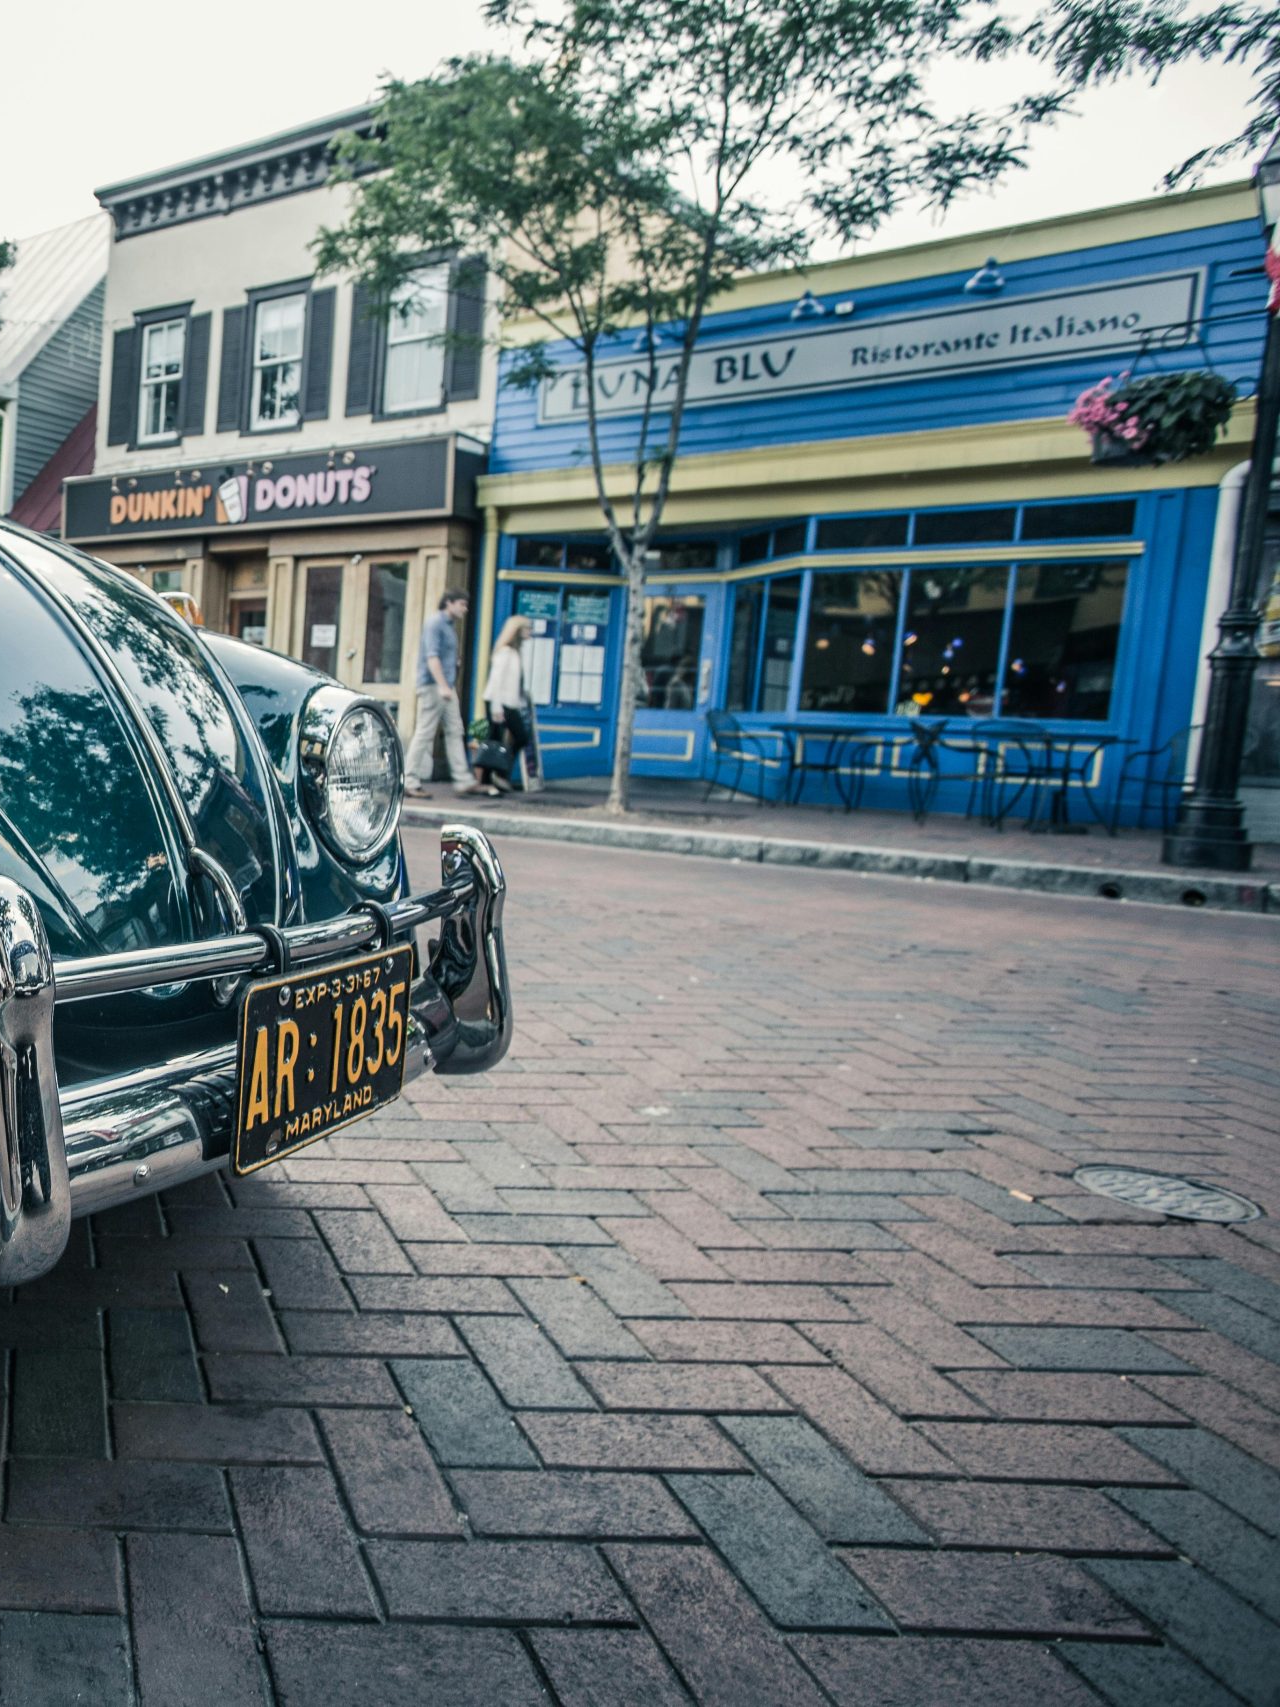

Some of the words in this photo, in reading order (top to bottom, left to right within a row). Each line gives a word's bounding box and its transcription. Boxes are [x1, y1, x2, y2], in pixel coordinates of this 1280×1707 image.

[1010, 312, 1141, 345] Italiano
[110, 484, 211, 525] DUNKIN'
[254, 466, 372, 512] DONUTS
[285, 1085, 373, 1141] MARYLAND
